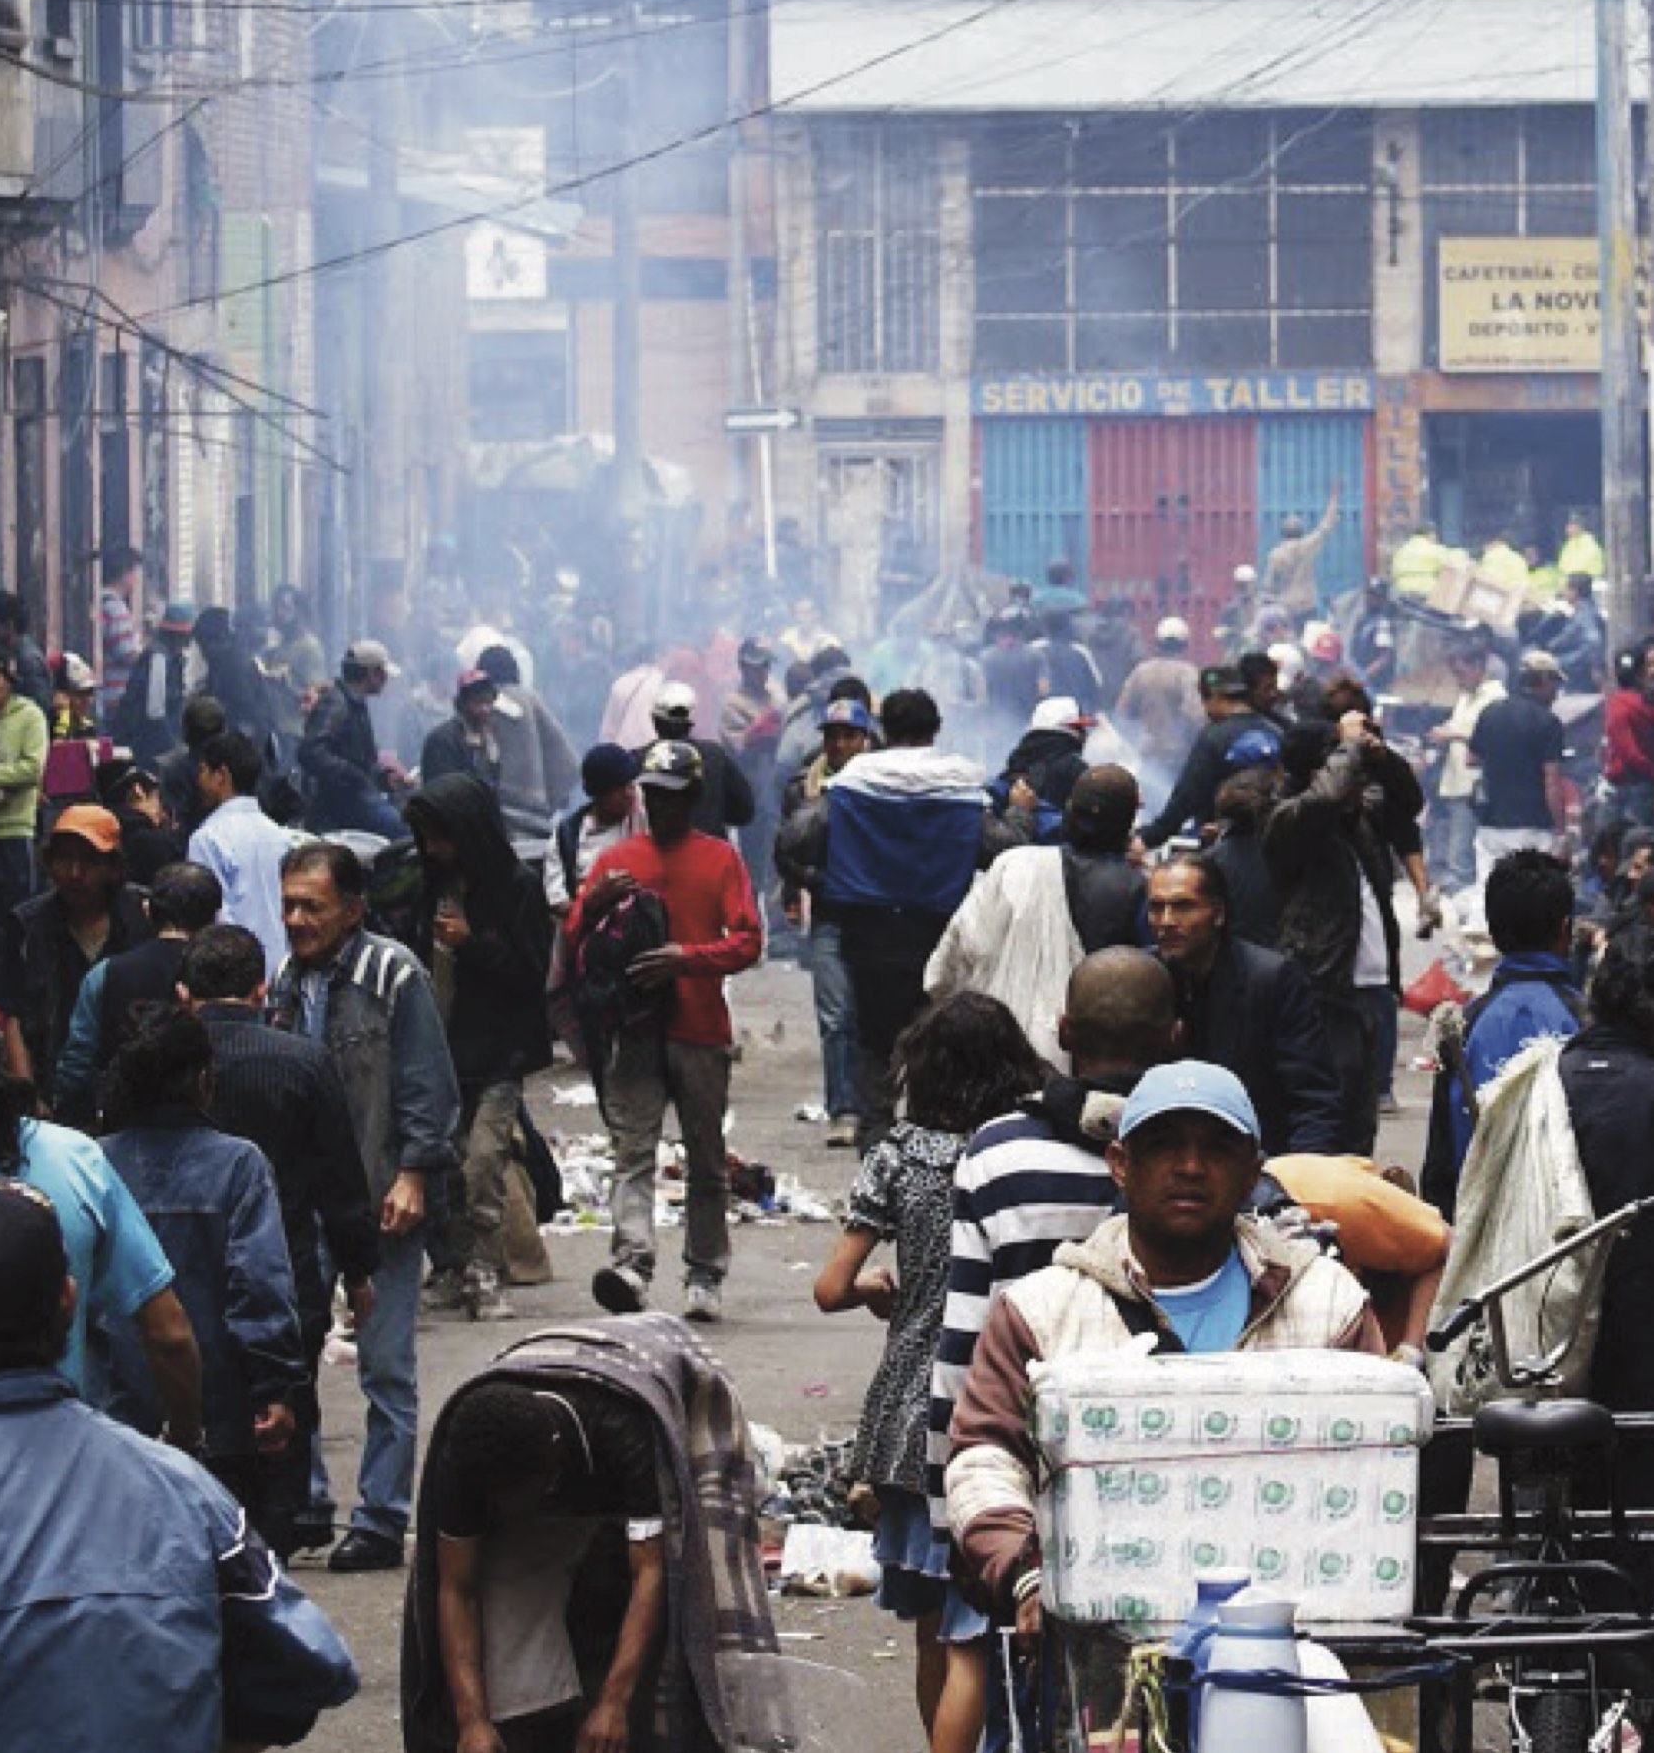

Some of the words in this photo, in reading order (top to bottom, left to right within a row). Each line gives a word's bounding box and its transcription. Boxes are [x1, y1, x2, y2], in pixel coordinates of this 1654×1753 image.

[1491, 291, 1524, 311] LA
[981, 378, 1143, 413] SERVICIO
[1156, 381, 1192, 402] DE
[1205, 376, 1372, 411] TALLER
